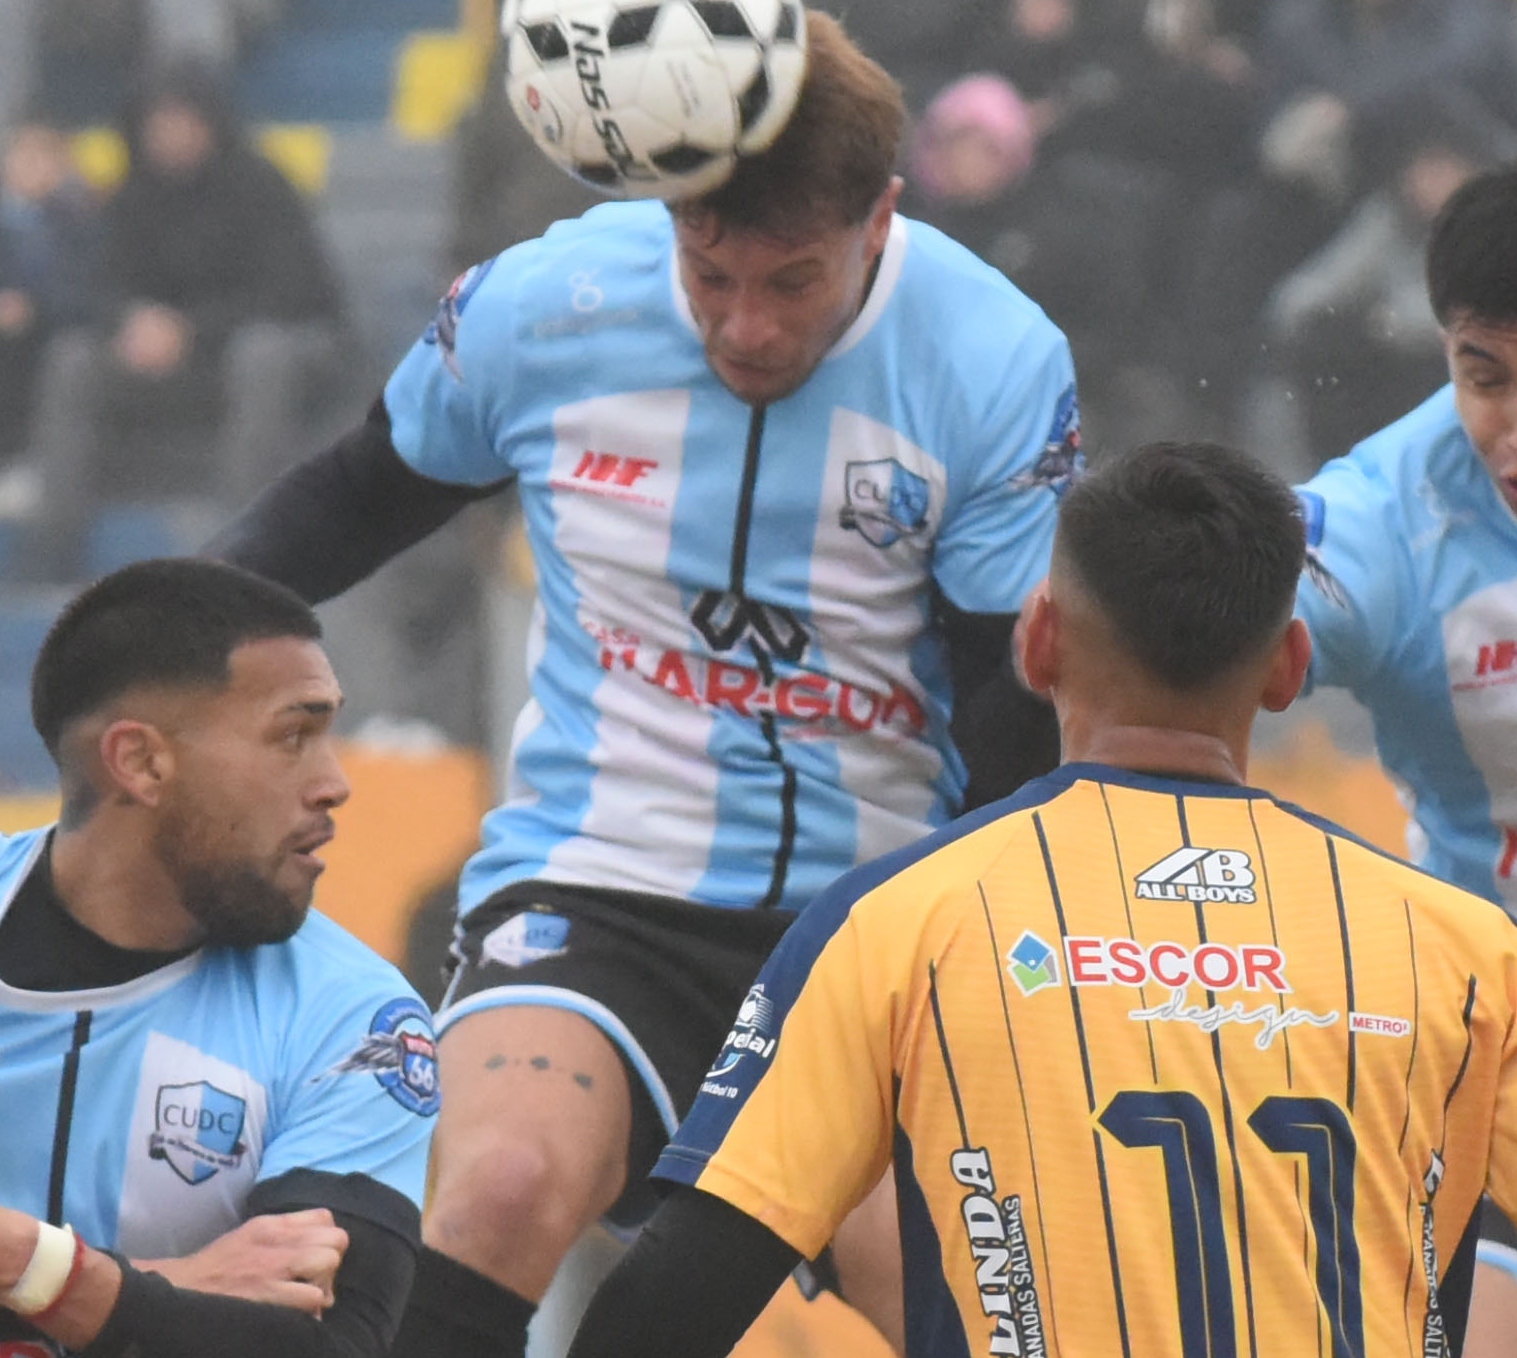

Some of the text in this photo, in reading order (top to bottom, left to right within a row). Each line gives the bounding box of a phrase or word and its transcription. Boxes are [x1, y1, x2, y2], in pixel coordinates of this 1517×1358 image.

[1136, 883, 1256, 903] ALL BOYS
[1067, 939, 1287, 990] ESCOR
[1132, 991, 1337, 1048] design
[163, 1103, 235, 1135] CUDC
[951, 1147, 1022, 1358] LINDA
